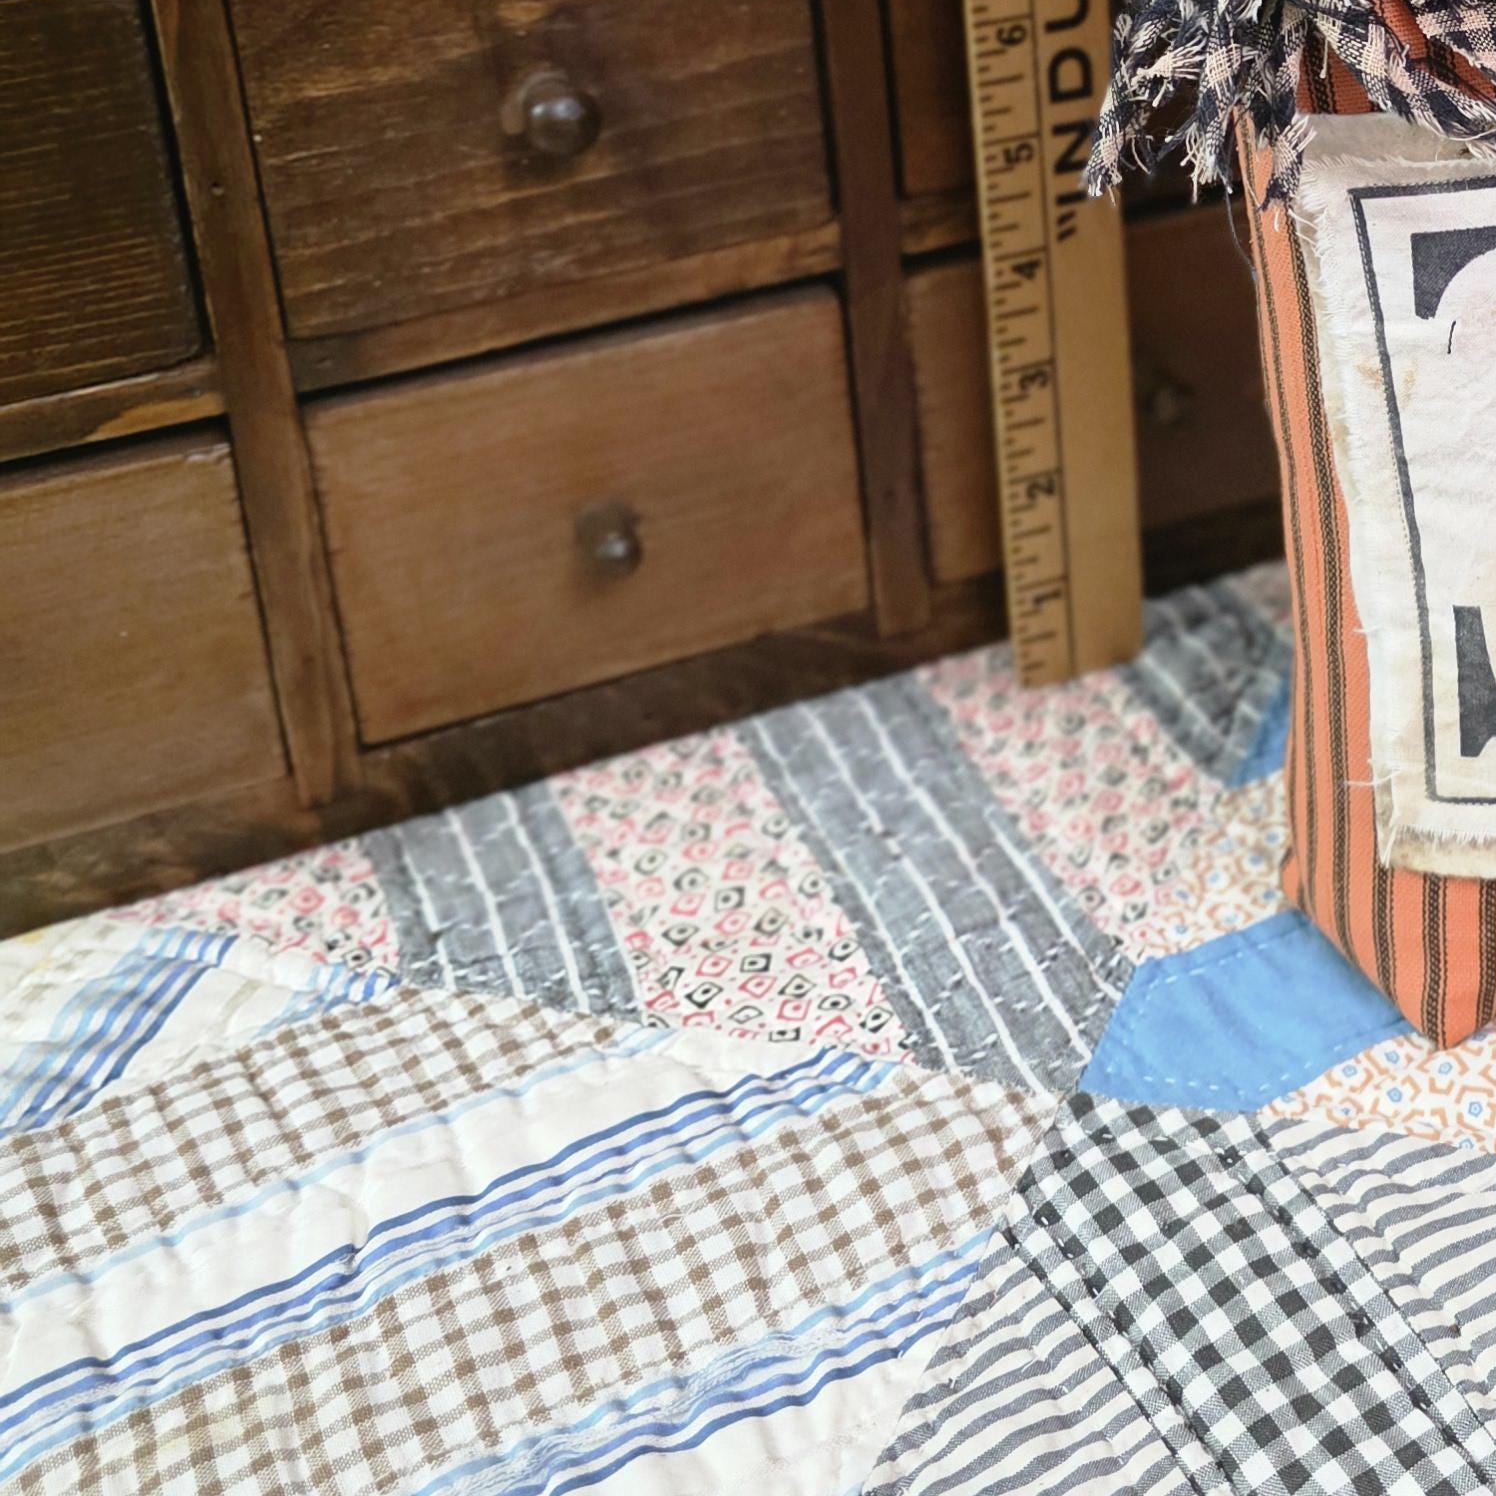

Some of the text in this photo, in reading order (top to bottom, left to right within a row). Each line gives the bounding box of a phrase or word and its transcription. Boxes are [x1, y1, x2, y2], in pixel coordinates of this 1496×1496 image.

[996, 24, 1027, 46] 6
[1003, 142, 1034, 166] 5
[1011, 260, 1042, 281] 4
[1019, 369, 1049, 391] 3
[1026, 477, 1056, 501] 2
